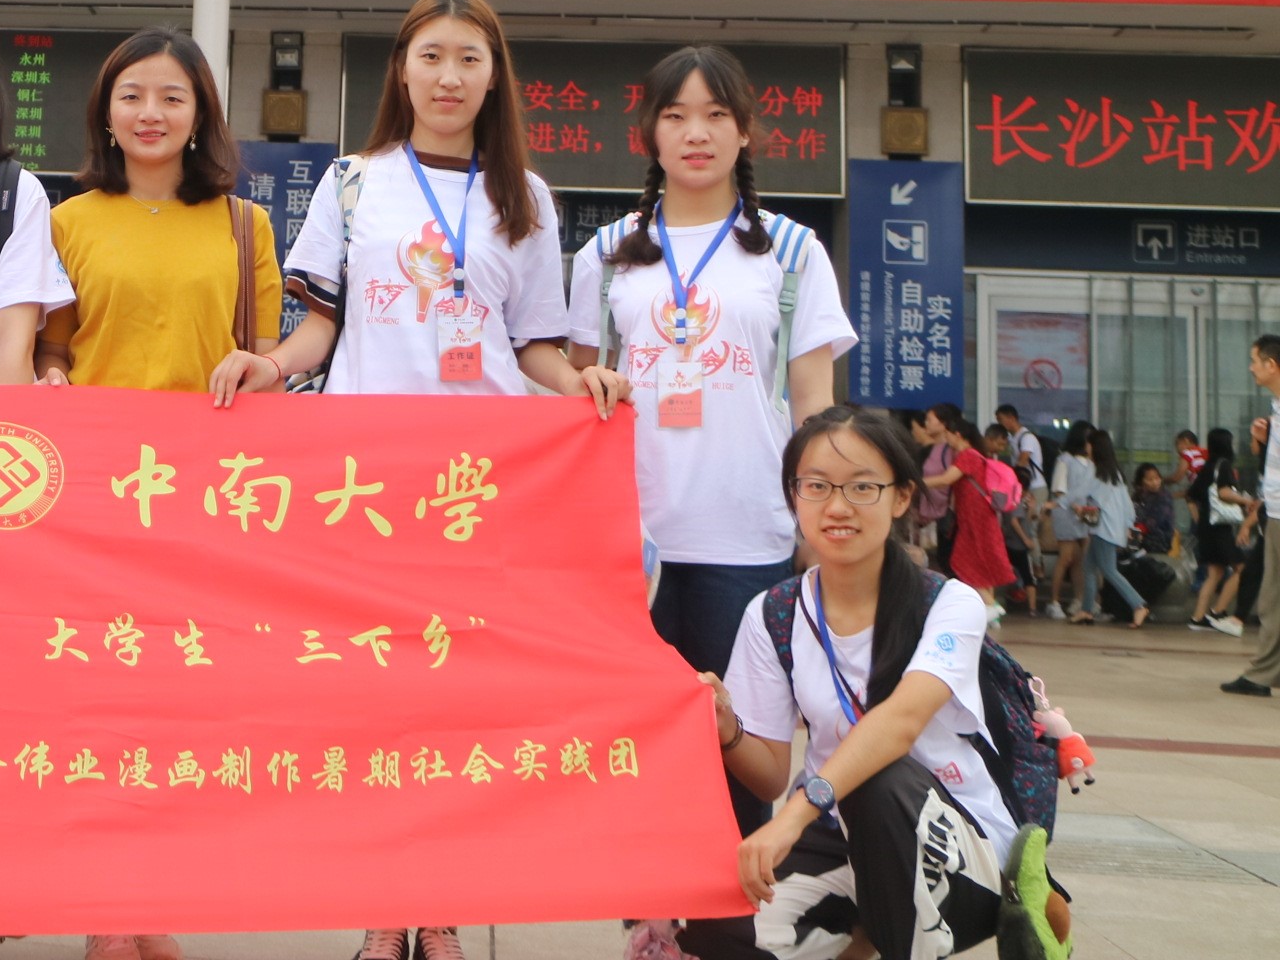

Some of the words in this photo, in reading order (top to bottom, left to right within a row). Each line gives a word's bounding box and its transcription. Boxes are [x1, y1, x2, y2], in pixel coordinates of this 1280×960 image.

[20, 53, 45, 66] 永州
[11, 70, 51, 84] 深圳东
[17, 89, 43, 102] 铜仁
[16, 107, 42, 120] 深圳
[15, 125, 41, 138] 深圳
[974, 93, 1280, 173] 长沙站欢
[1186, 224, 1259, 249] 进站口
[1186, 251, 1246, 265] Entrance
[884, 271, 895, 326] Automatic
[366, 315, 400, 325] QINGMENG
[899, 279, 925, 391] 自助检票
[927, 294, 952, 378] 实名制
[884, 327, 895, 360] Ticket
[448, 351, 475, 360] 工作证
[884, 361, 895, 397] Check
[712, 382, 734, 391] HUIGE
[25, 432, 59, 493] UNIVERSITY
